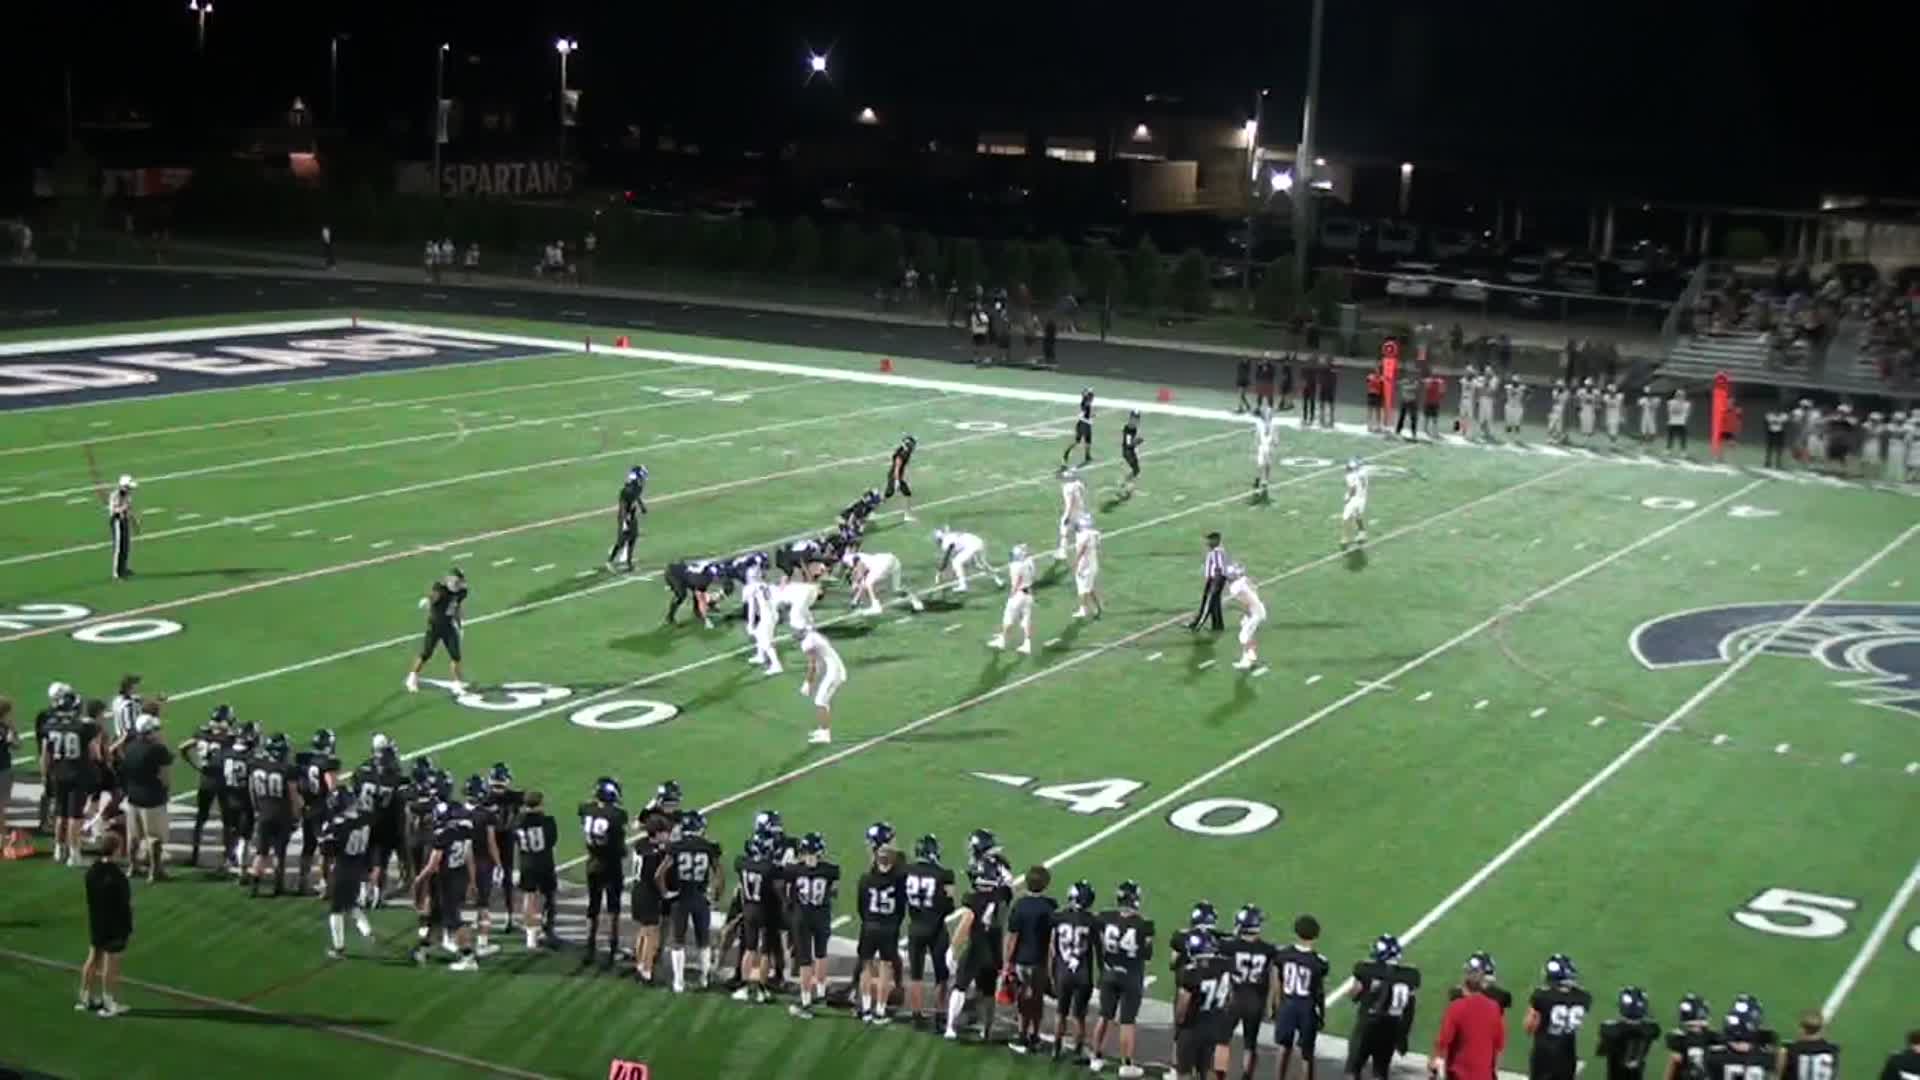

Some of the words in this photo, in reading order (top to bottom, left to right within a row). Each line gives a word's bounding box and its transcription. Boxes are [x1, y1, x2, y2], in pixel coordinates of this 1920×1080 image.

[442, 161, 576, 197] SPARTANS
[456, 682, 679, 730] 30
[1032, 777, 1280, 835] 40
[677, 850, 709, 882] 22
[868, 885, 897, 914] 15
[905, 874, 937, 907] 27
[1104, 924, 1139, 958] 64
[1231, 951, 1267, 984] 52
[1200, 971, 1232, 1010] 74
